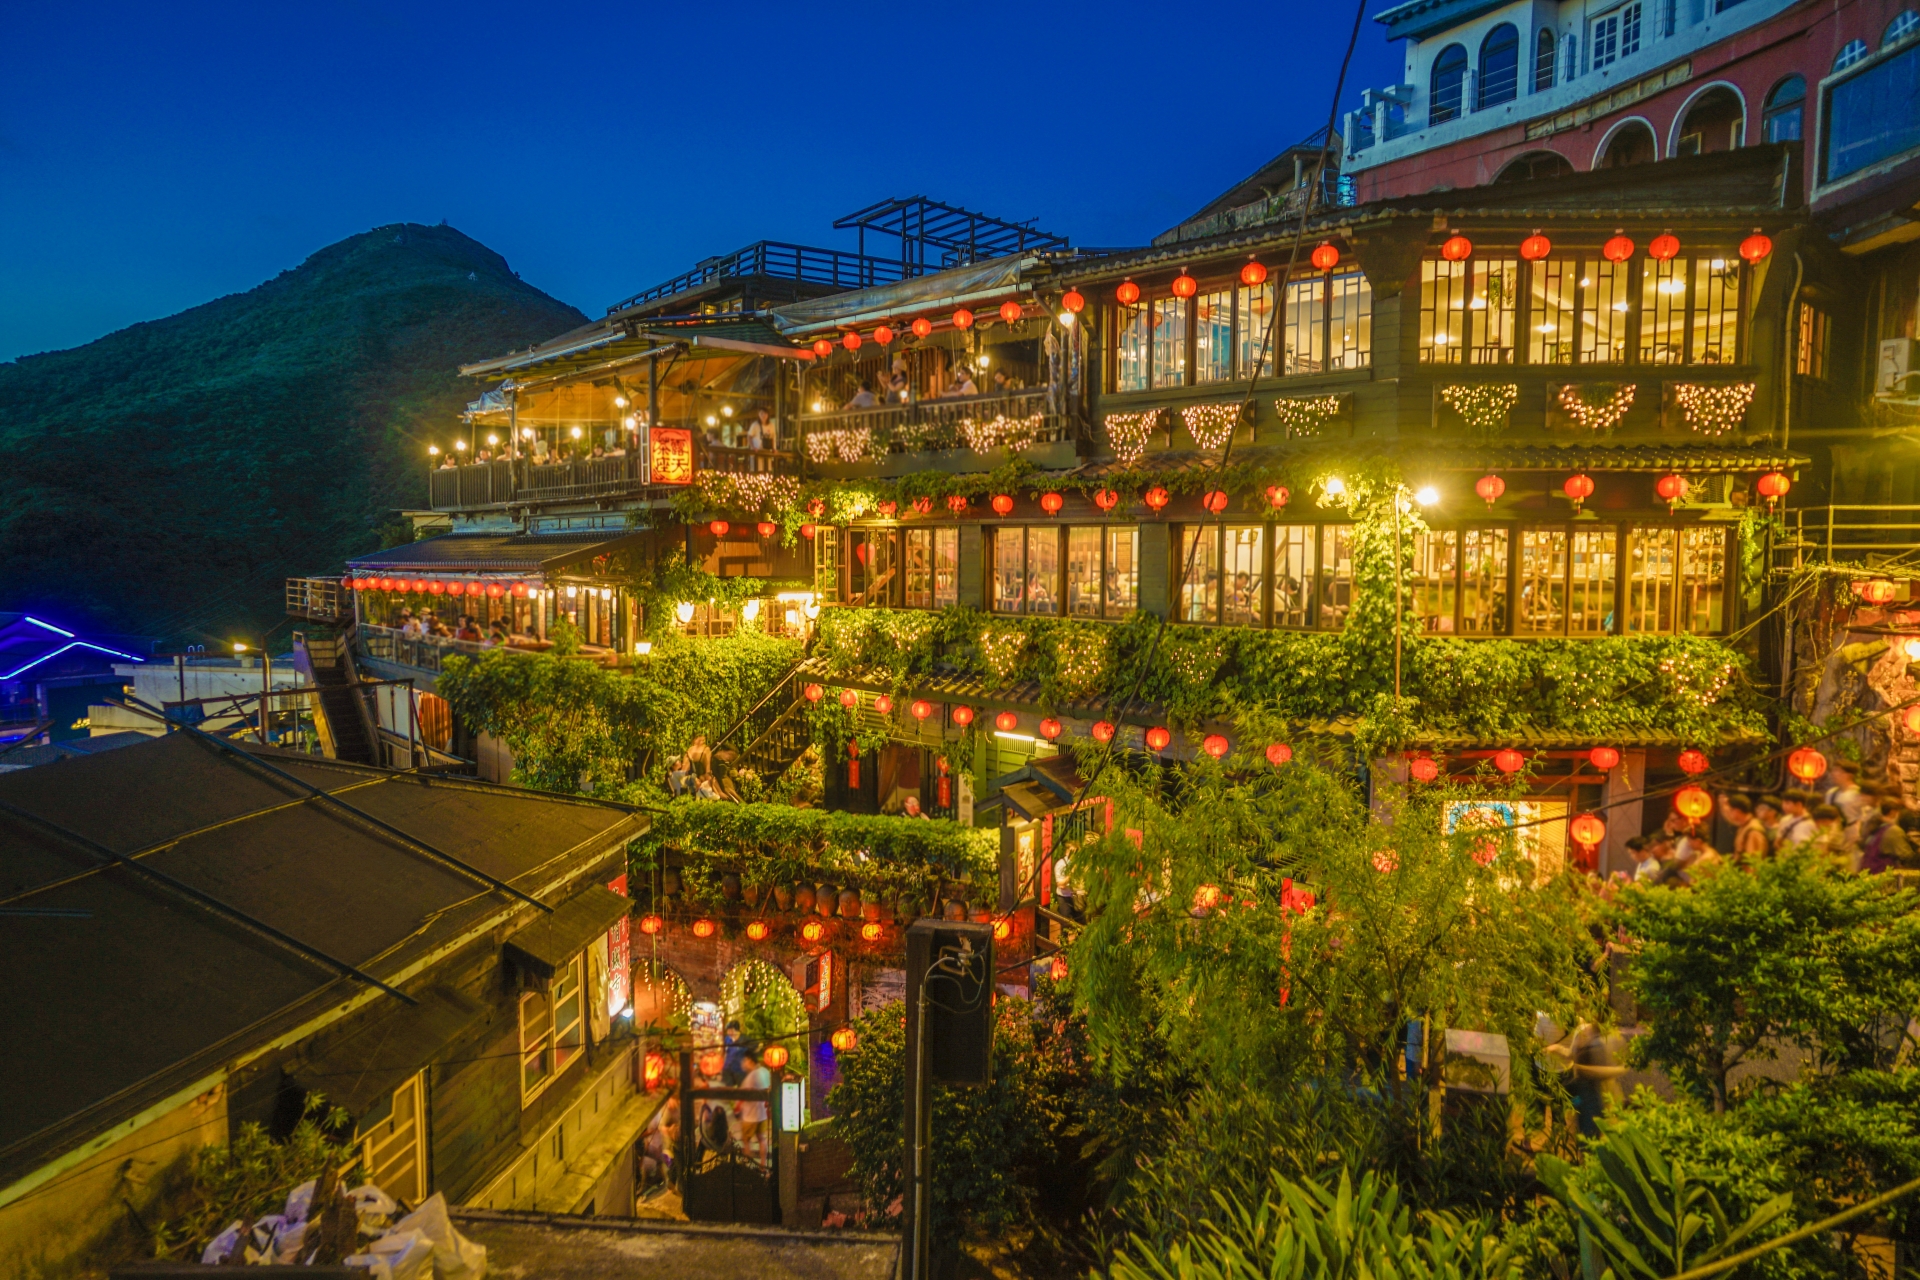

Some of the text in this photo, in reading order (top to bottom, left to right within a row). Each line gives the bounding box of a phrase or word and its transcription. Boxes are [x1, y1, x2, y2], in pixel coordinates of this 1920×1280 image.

[653, 437, 670, 473] 茶座
[671, 438, 688, 473] 露天
[610, 886, 622, 1001] 情城市
